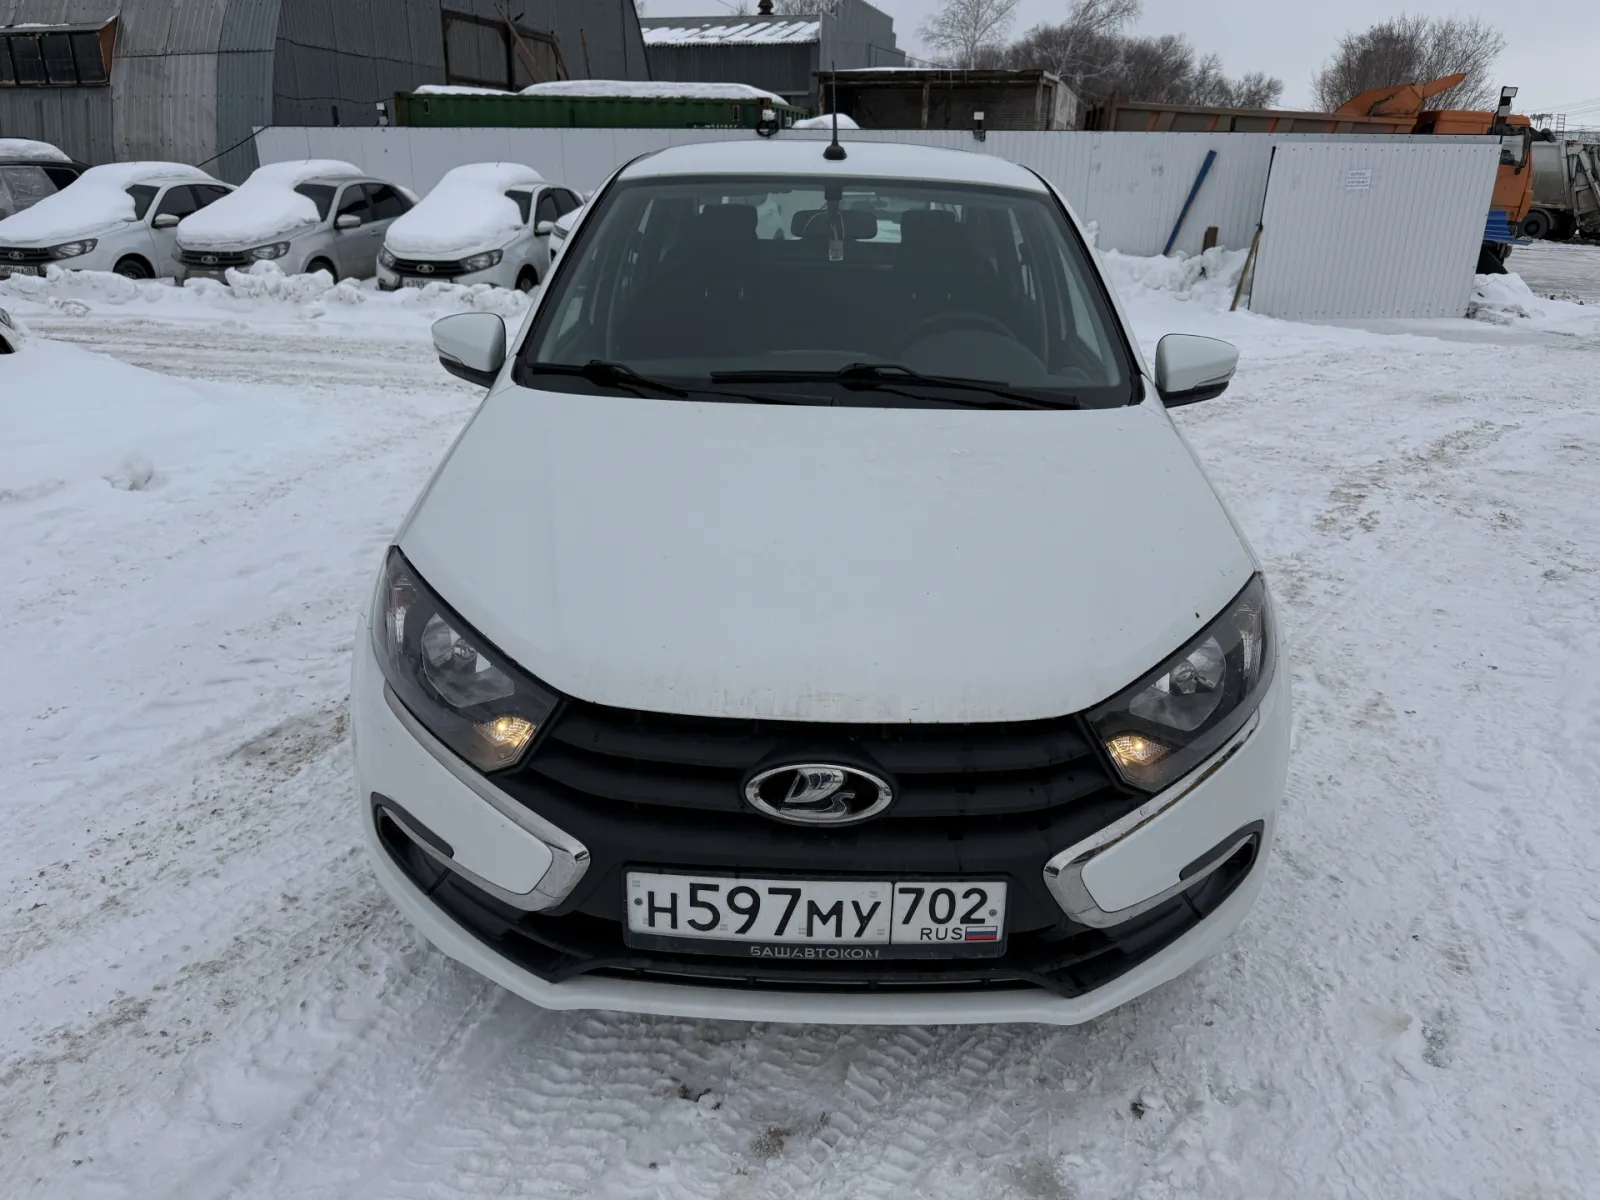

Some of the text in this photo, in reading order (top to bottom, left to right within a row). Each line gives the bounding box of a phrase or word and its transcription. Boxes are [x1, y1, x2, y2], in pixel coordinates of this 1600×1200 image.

[647, 882, 988, 938] Н597МУ 702
[920, 927, 963, 941] RUS
[750, 945, 880, 959] БАШАВТОКОМ
